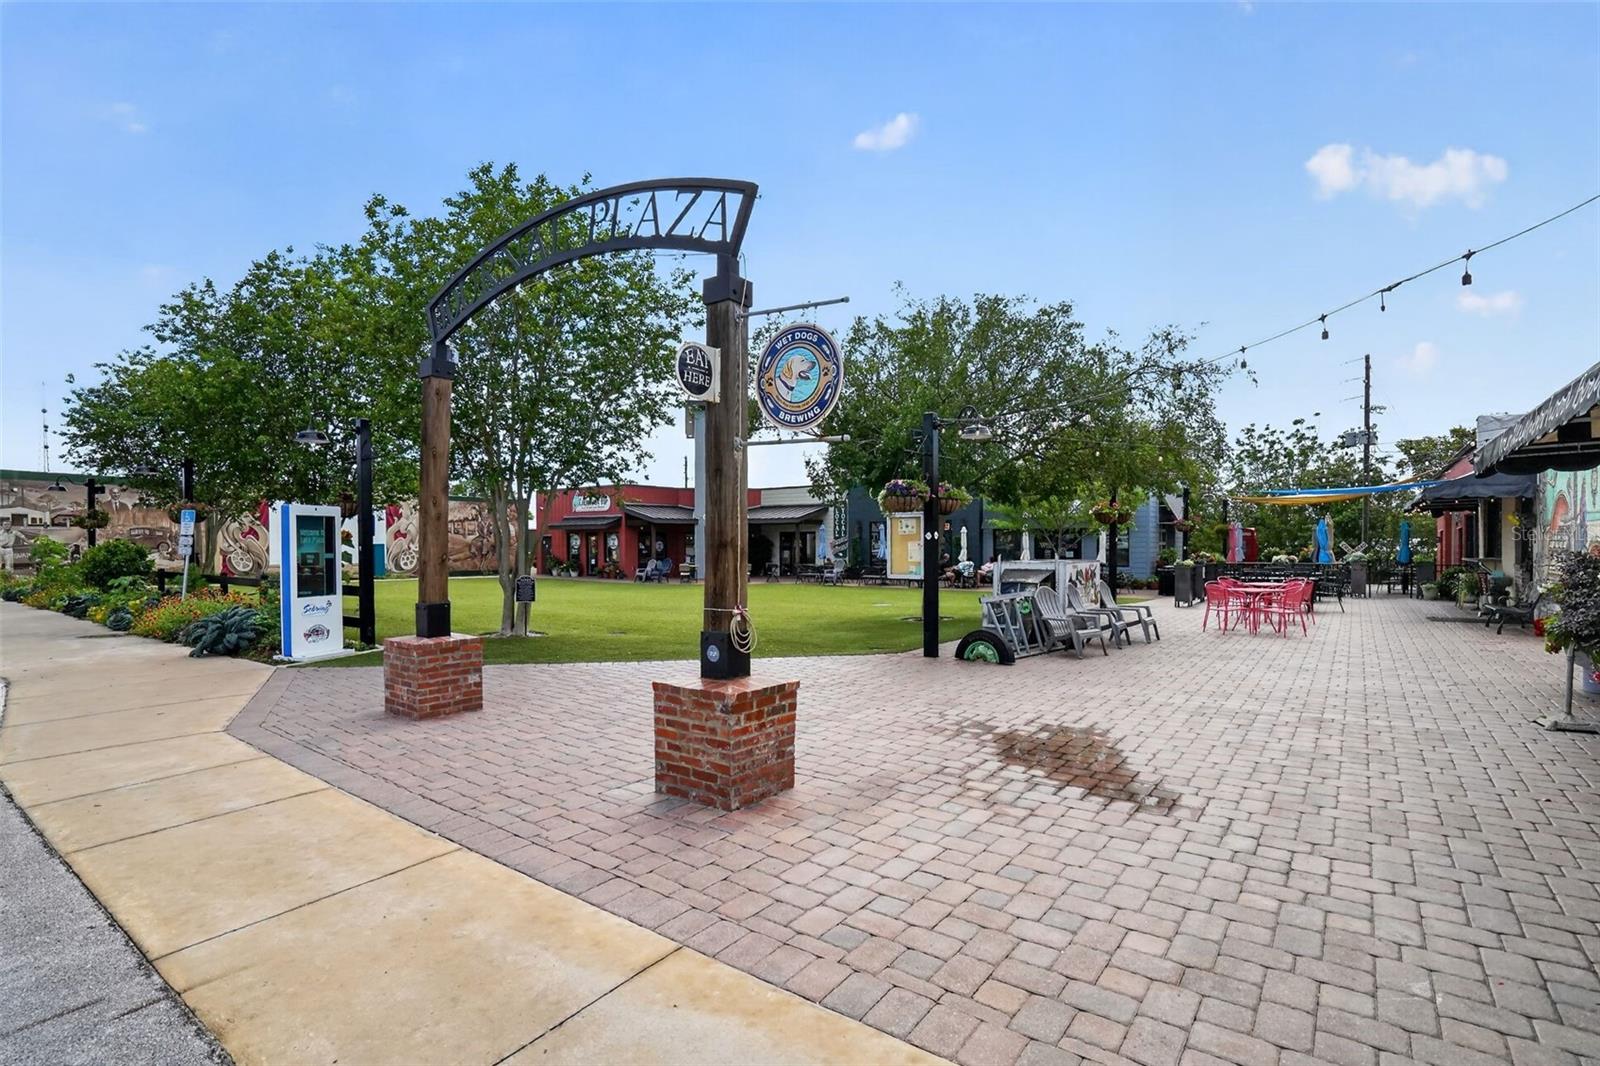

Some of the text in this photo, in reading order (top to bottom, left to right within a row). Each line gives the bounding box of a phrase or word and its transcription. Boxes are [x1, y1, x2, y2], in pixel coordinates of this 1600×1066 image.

[588, 188, 730, 244] PLAZA
[775, 331, 819, 350] WET DOGS
[685, 348, 709, 369] EAT
[683, 369, 710, 388] HERE
[778, 405, 821, 423] BREWING
